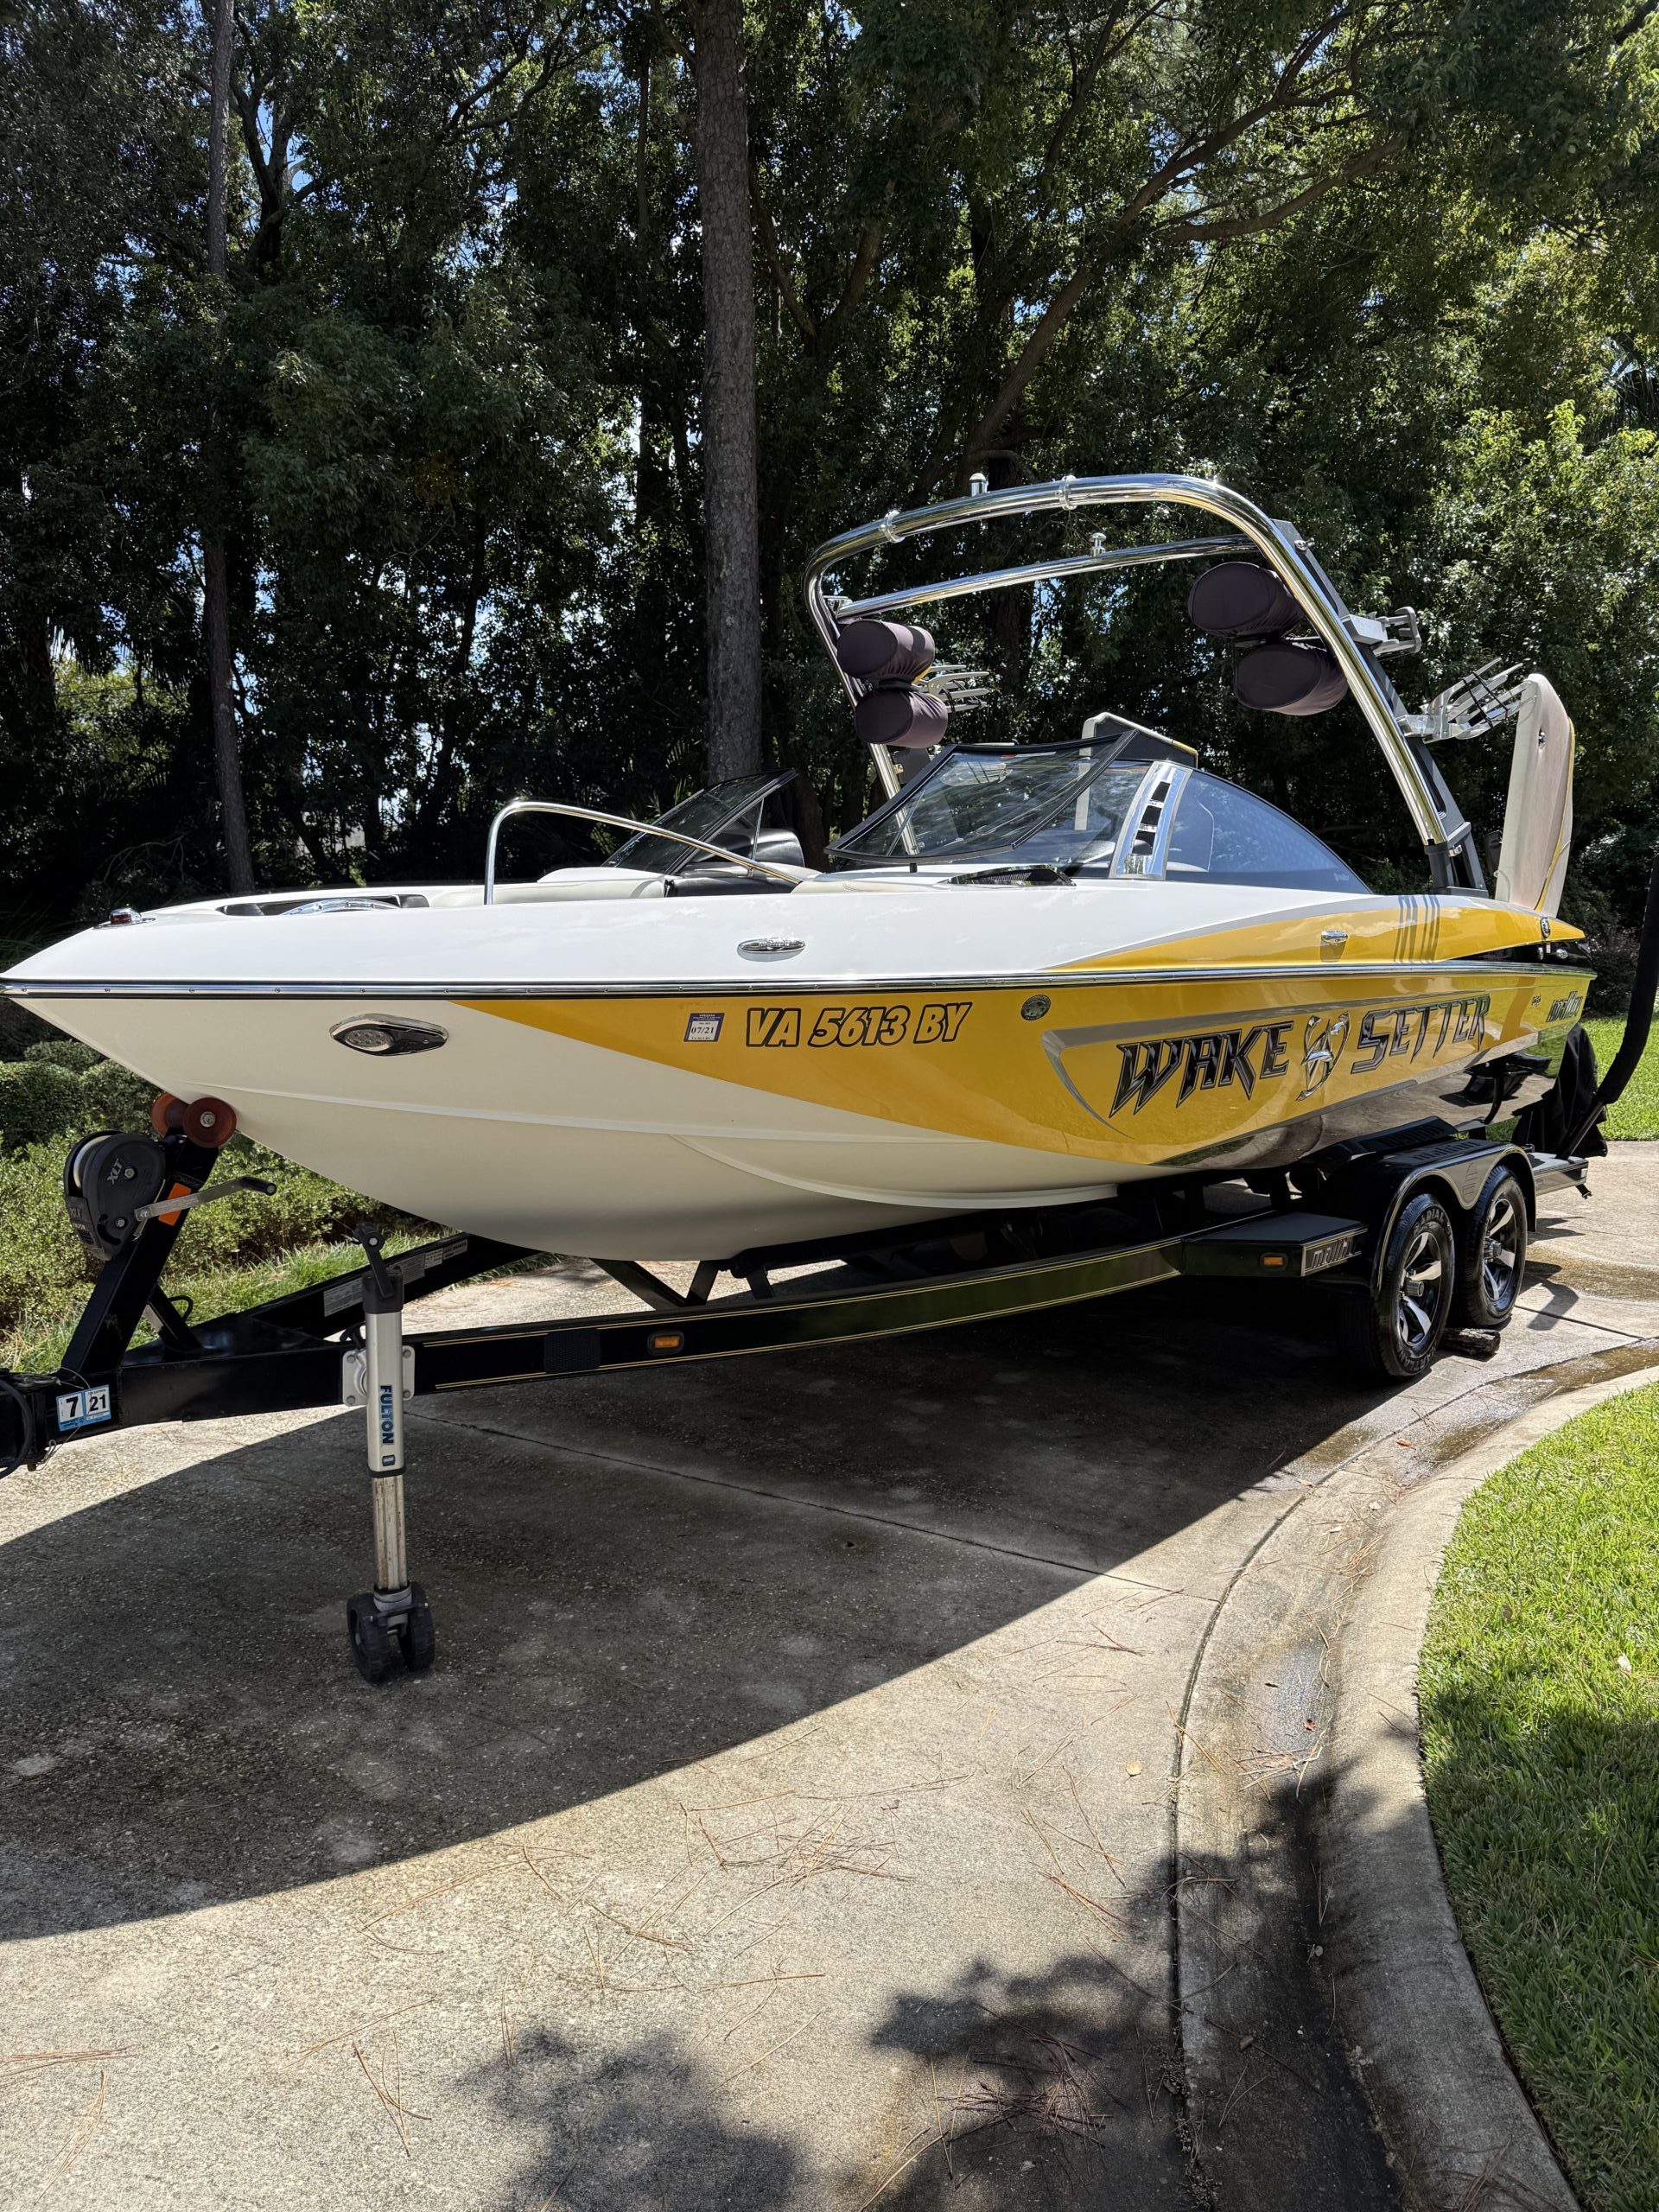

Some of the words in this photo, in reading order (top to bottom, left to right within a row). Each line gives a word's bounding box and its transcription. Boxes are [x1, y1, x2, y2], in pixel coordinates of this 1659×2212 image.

[746, 1007, 801, 1047] VA
[807, 1005, 911, 1048] 5613
[912, 1001, 972, 1044] BY
[1109, 1020, 1294, 1119] WAKE
[1351, 994, 1491, 1075] SETTER
[106, 1158, 122, 1185] XLT
[66, 1395, 79, 1418] 7
[89, 1394, 106, 1412] 21
[380, 1385, 394, 1444] FULTON
